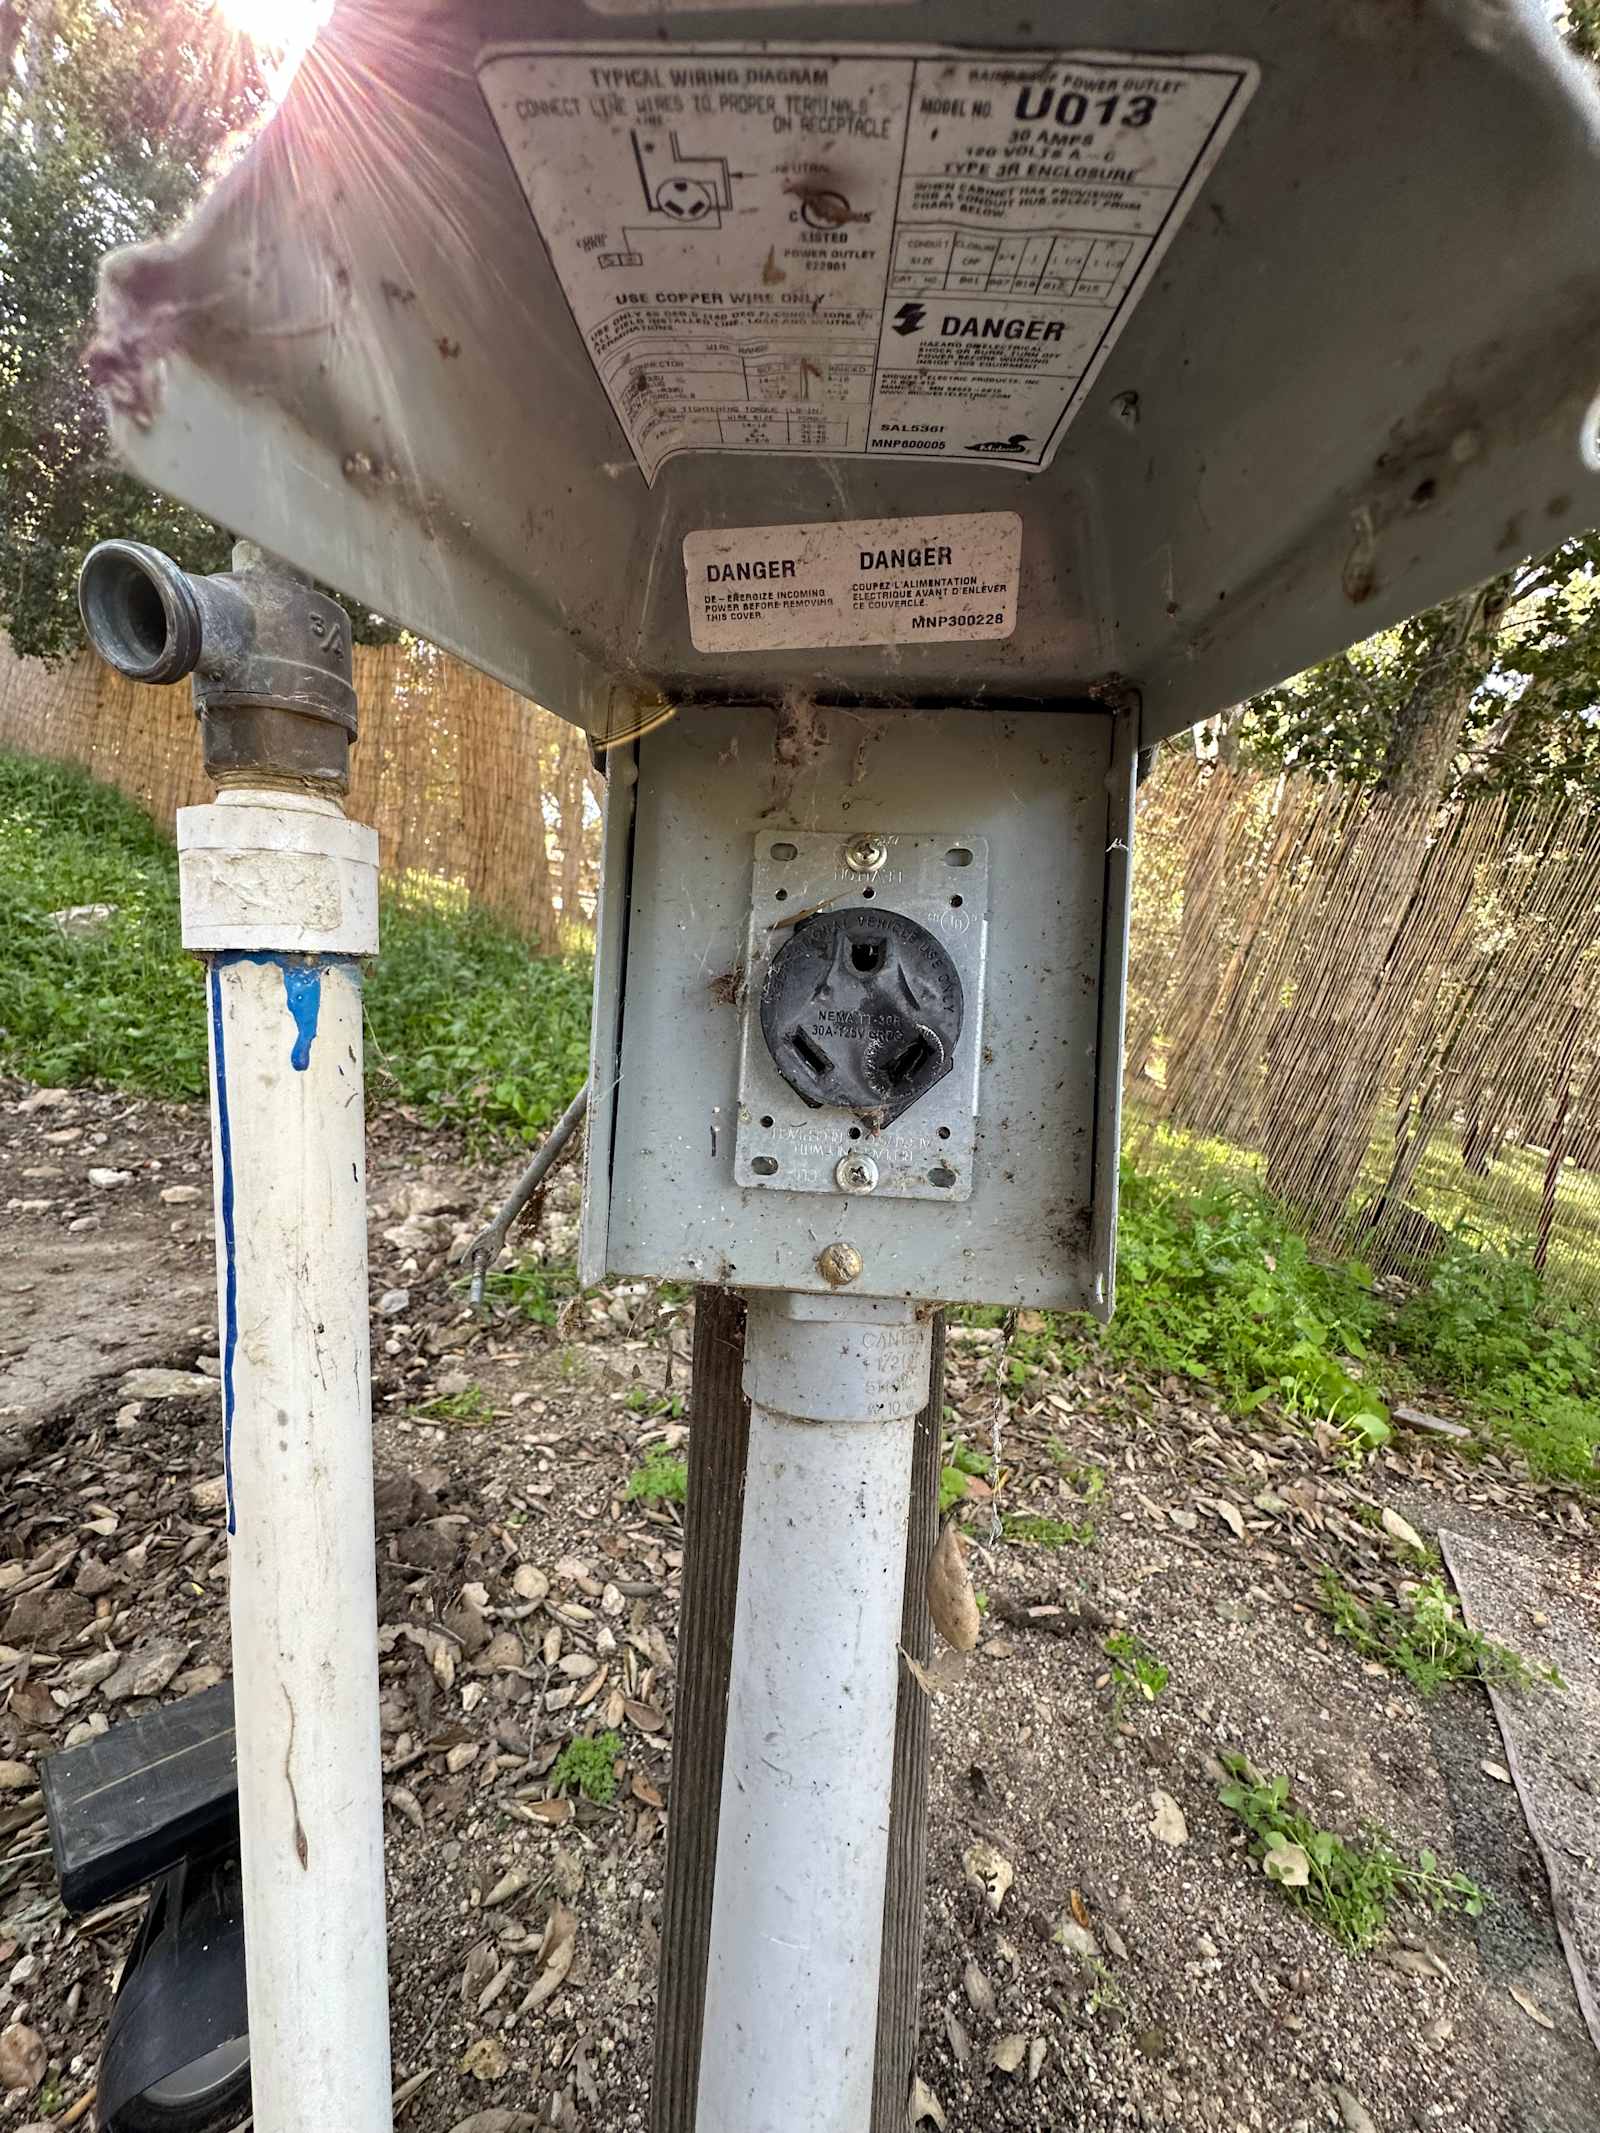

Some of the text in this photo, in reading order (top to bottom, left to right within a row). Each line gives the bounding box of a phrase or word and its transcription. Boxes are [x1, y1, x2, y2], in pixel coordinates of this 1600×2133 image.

[588, 68, 828, 87] TYPICAL WIRING DIAGRAM
[1121, 79, 1182, 94] OUTLET
[719, 93, 776, 114] PROPER
[919, 95, 966, 118] MODEL
[1014, 86, 1157, 128] U013
[799, 115, 891, 139] RECEPTACLE
[1036, 130, 1094, 147] AMPS
[943, 161, 988, 177] TYPE
[1026, 162, 1138, 183] ENCLOSURE
[800, 231, 848, 243] LISTED
[784, 248, 876, 259] POWER OUTLET
[615, 292, 825, 305] USE COPPER WIRE ONLY
[940, 316, 1066, 342] DANGER
[859, 546, 952, 570] DANGER
[706, 559, 796, 583] DANGER
[852, 576, 978, 592] COUPEZ L'ALIMENTATION
[776, 589, 827, 600] INCOMING
[915, 588, 949, 600] AVANT
[704, 597, 834, 614] POWER BEFORE REMOVING
[852, 602, 865, 611] CE
[706, 613, 727, 622] THIS
[911, 613, 1004, 630] MNP300228
[308, 611, 345, 663] 3/4
[918, 945, 944, 972] USE
[935, 972, 957, 1014] ONLY
[816, 1009, 855, 1025] NEMA
